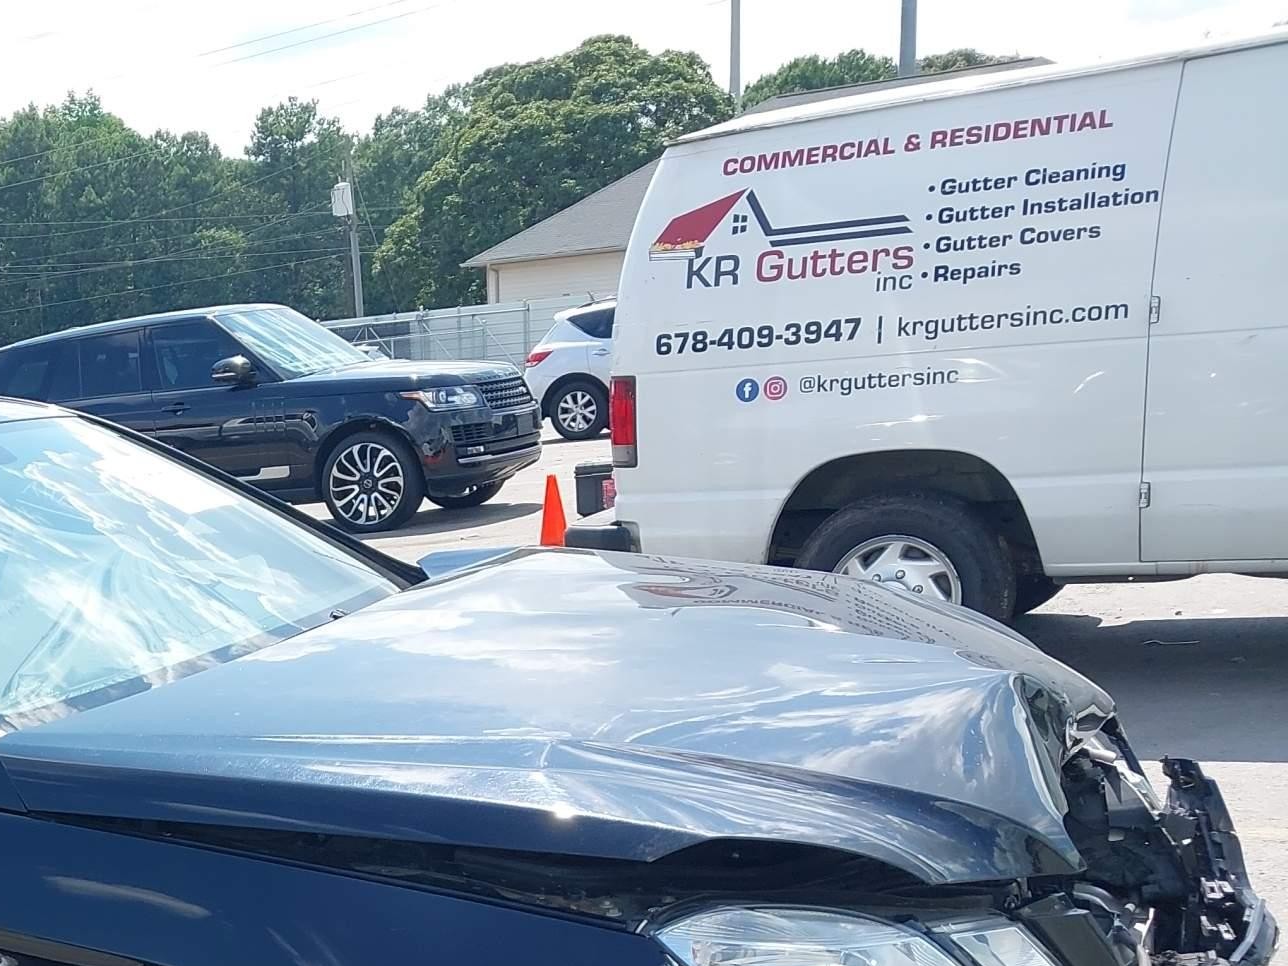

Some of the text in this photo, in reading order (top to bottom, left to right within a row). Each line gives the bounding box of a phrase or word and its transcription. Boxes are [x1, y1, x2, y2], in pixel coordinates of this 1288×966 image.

[722, 109, 1114, 176] COMMERCIAL & RESIDENTIAL
[940, 162, 1127, 196] Gutter Cleaning
[937, 188, 1159, 224] Gutter Installation
[935, 225, 1102, 253] Gutter Covers
[686, 245, 915, 289] KR Gutters
[875, 271, 914, 293] inc
[933, 260, 1022, 284] Repairs
[655, 317, 862, 355] 678-409-3947
[897, 303, 1130, 341] krguttersinc.com
[799, 366, 959, 396] @krguttersinc
